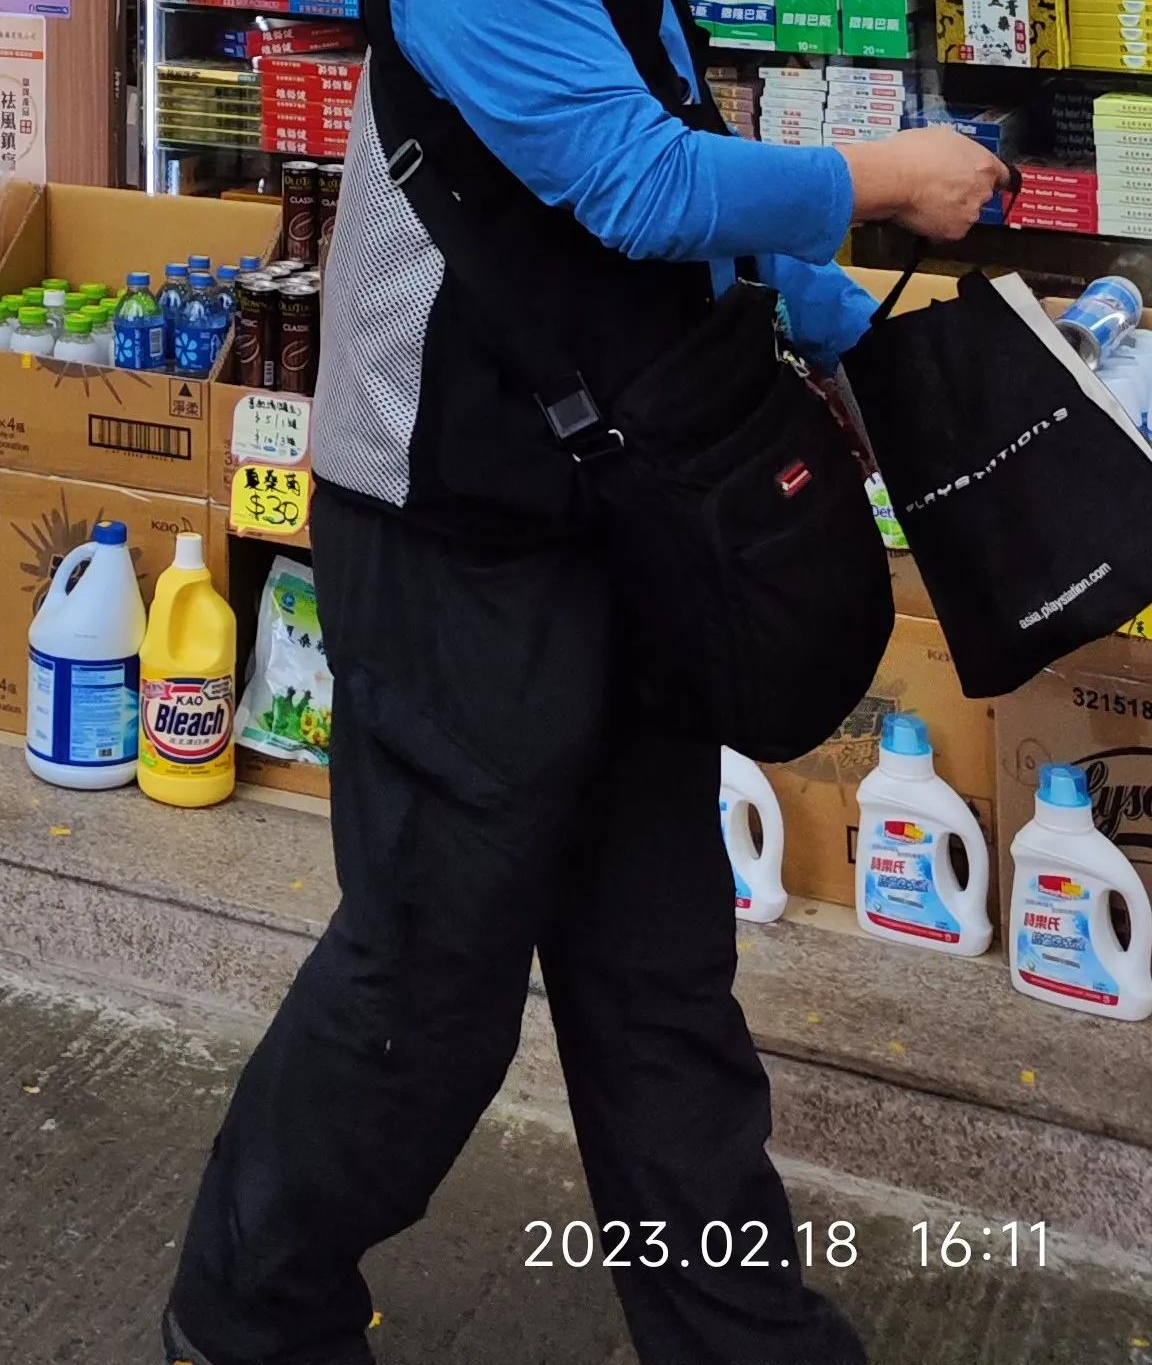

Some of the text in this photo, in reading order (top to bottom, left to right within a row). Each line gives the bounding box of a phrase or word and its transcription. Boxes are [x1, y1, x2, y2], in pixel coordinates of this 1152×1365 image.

[244, 491, 300, 526] $30
[1019, 562, 1112, 631] asia.playstation.com
[175, 693, 204, 706] KAO
[155, 704, 225, 736] Bleach
